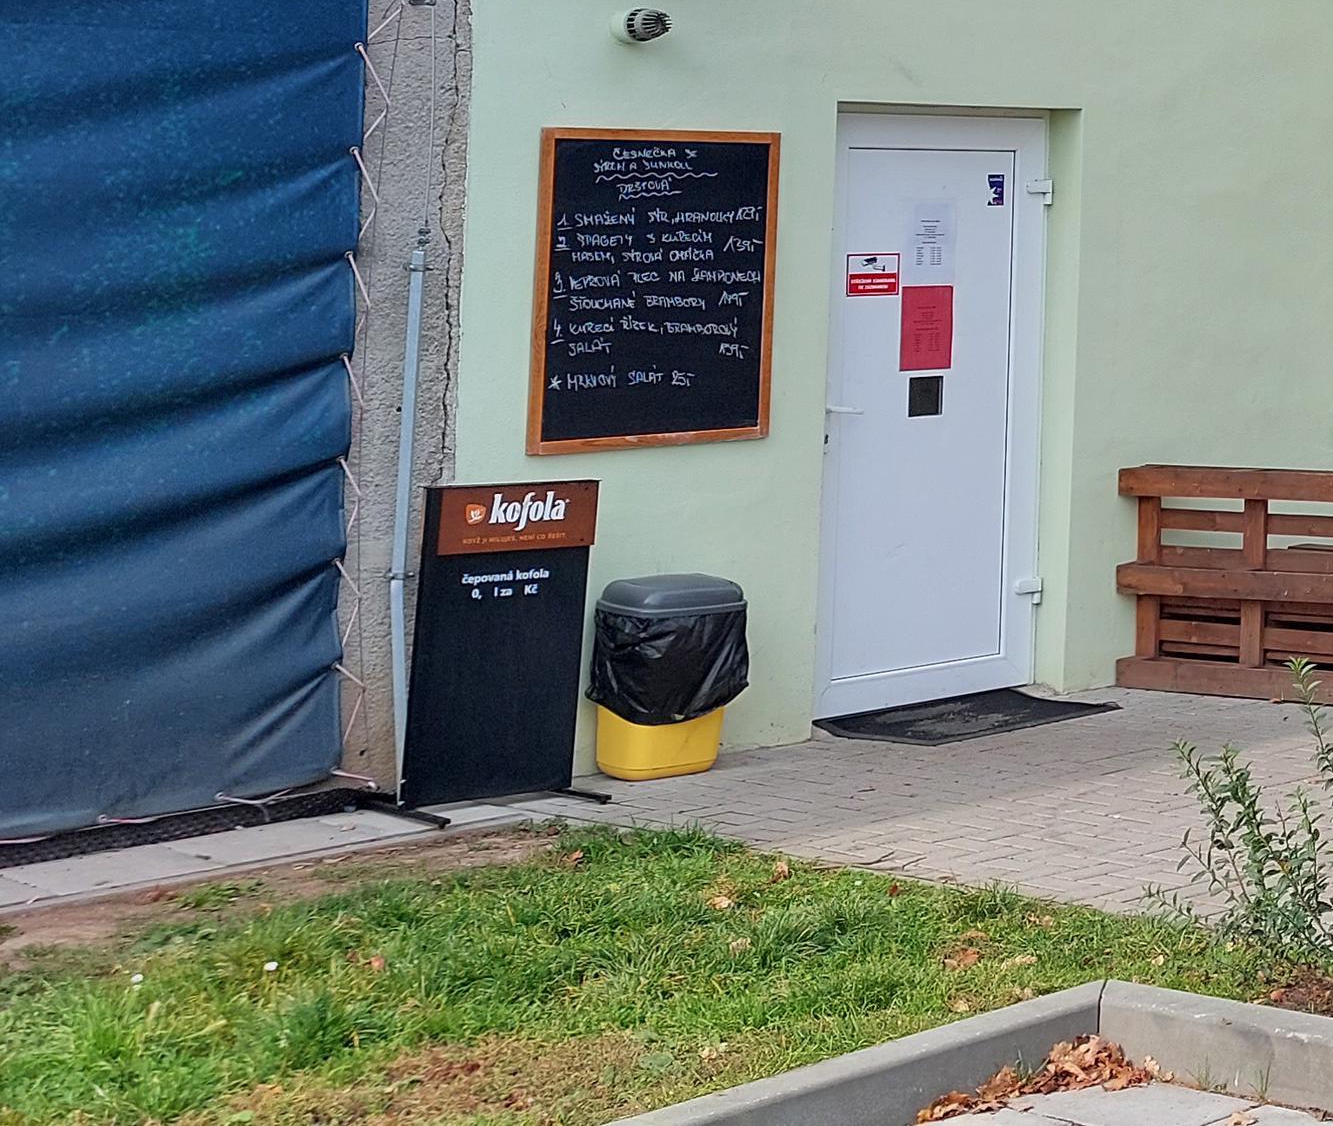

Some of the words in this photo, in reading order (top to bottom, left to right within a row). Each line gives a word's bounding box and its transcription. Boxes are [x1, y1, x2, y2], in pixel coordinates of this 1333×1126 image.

[630, 162, 637, 170] A
[574, 207, 636, 227] SMAŽENÝ
[669, 271, 685, 283] NA
[568, 337, 612, 357] SALÁT
[628, 365, 664, 385] SALÁT
[488, 490, 566, 531] kofola
[461, 570, 514, 586] čepovaná
[515, 568, 550, 581] kofola
[500, 588, 513, 596] za
[524, 583, 538, 595] Kč
